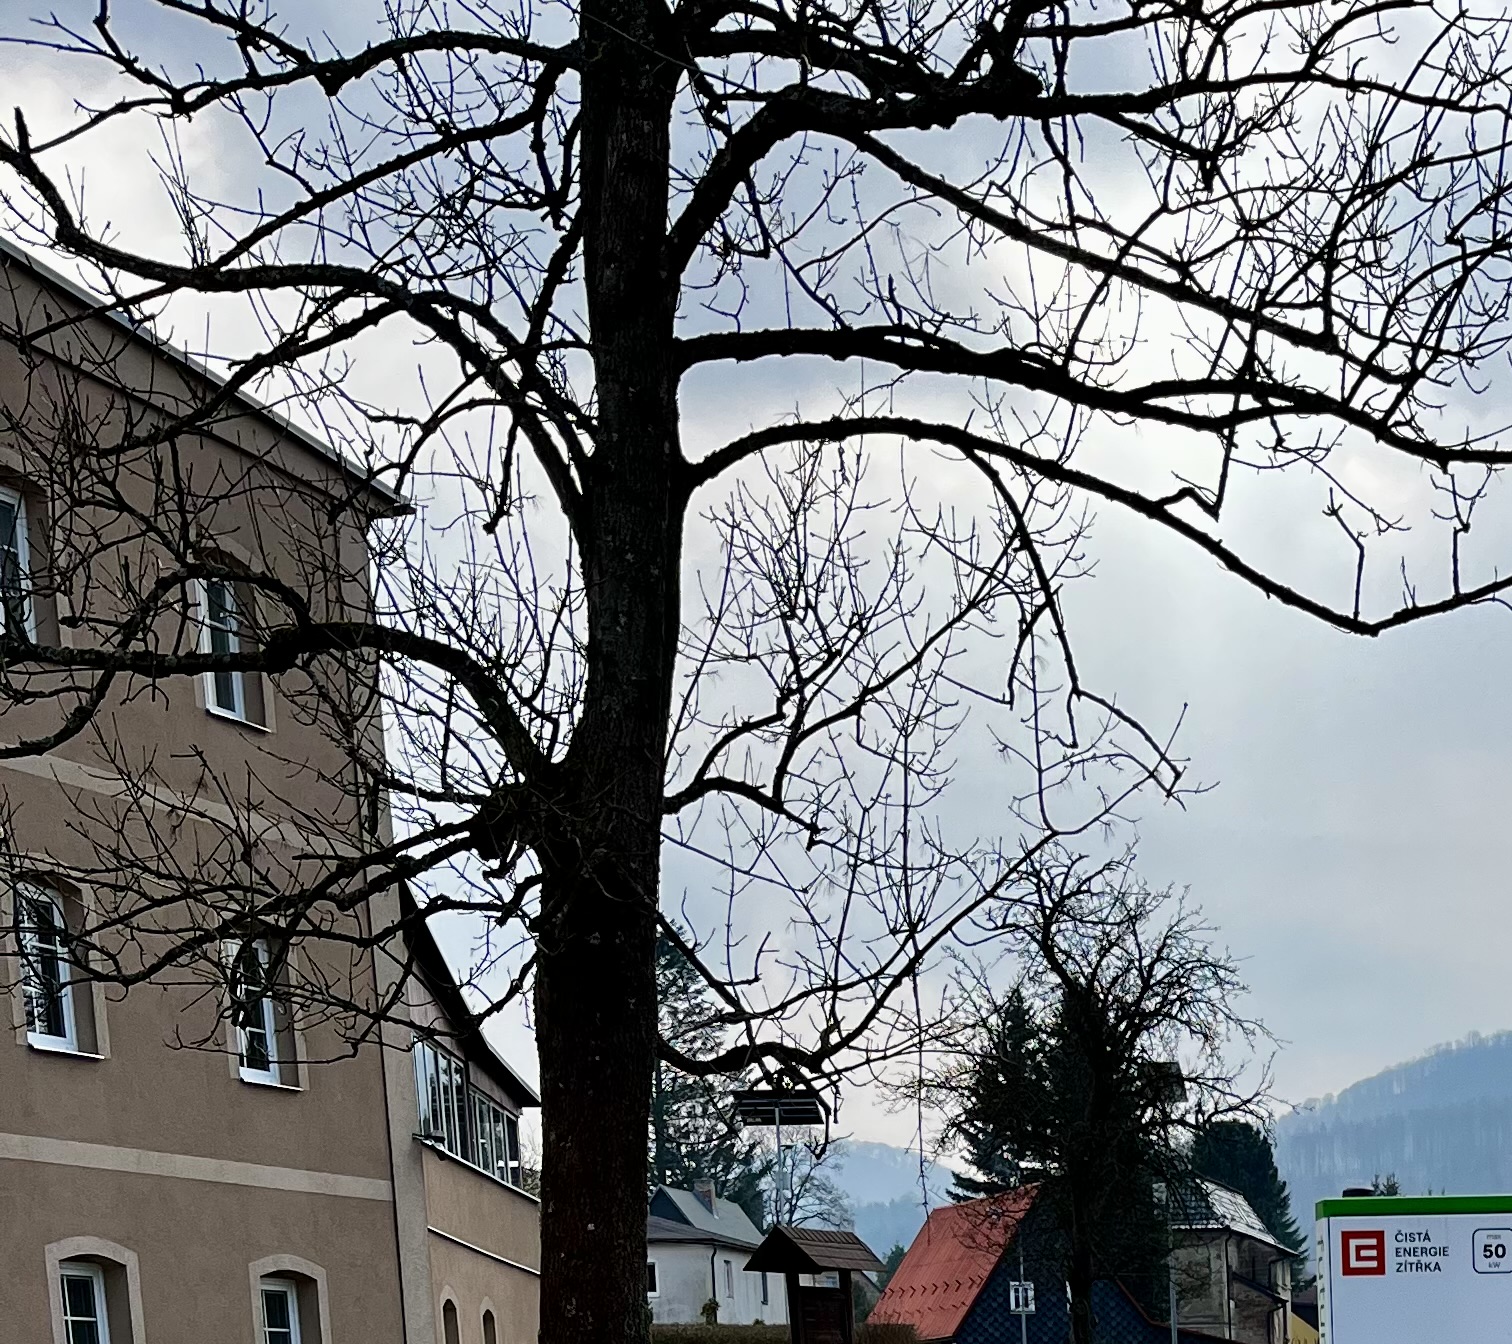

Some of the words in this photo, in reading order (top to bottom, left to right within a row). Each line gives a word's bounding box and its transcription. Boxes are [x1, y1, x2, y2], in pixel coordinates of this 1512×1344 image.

[1395, 1229, 1431, 1243] ČISTÁ
[1395, 1246, 1450, 1258] ENERGIE
[1482, 1243, 1507, 1259] 50
[1396, 1261, 1442, 1273] ZÍTŘKA
